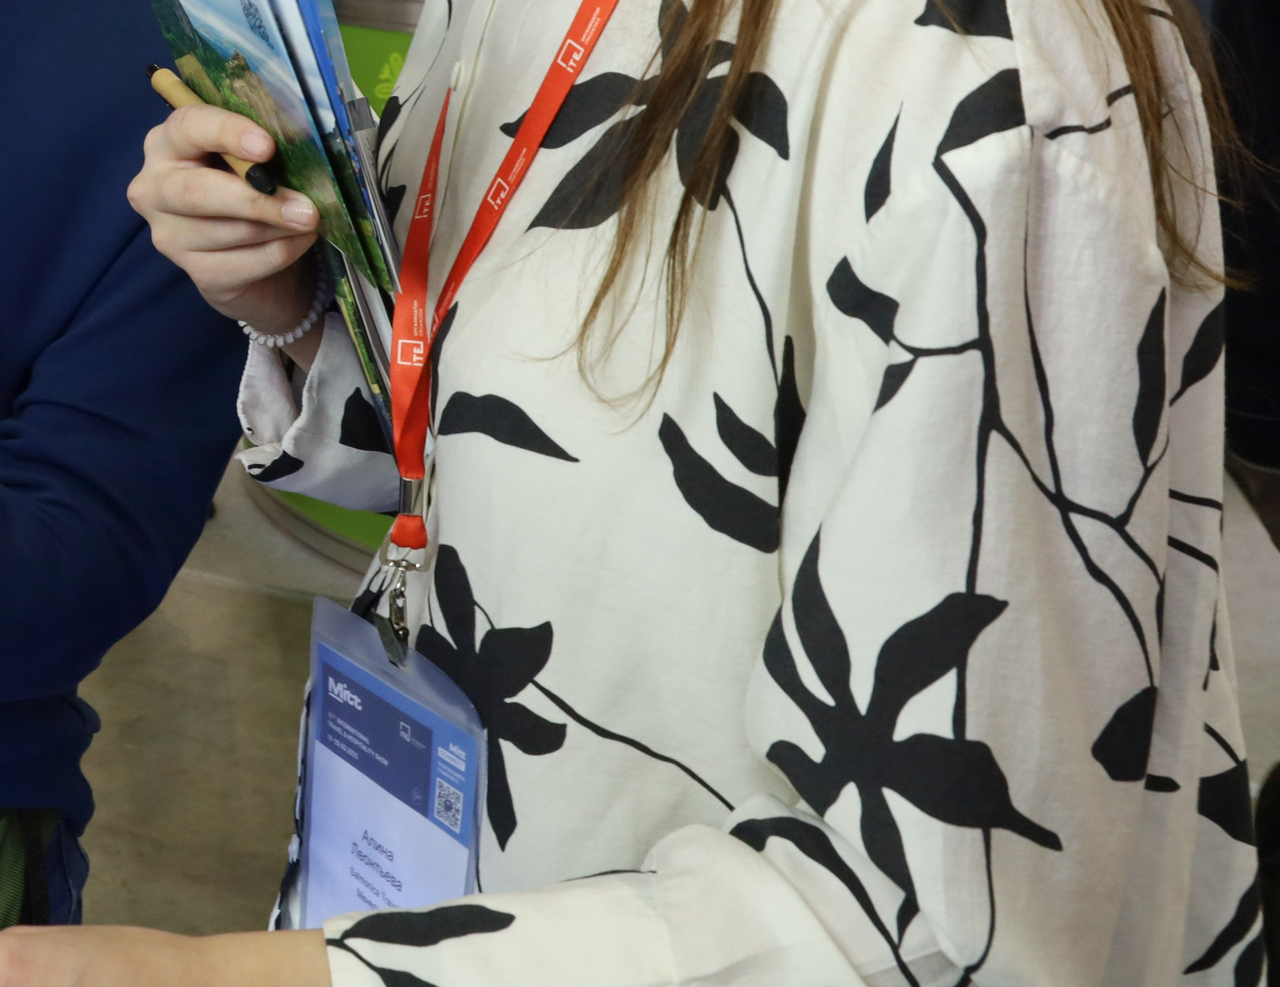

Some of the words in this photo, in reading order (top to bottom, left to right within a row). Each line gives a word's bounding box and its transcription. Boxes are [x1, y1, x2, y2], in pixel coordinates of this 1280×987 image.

[328, 676, 362, 711] Mitt
[362, 830, 393, 862] Алина
[351, 842, 402, 892] Леонтьева
